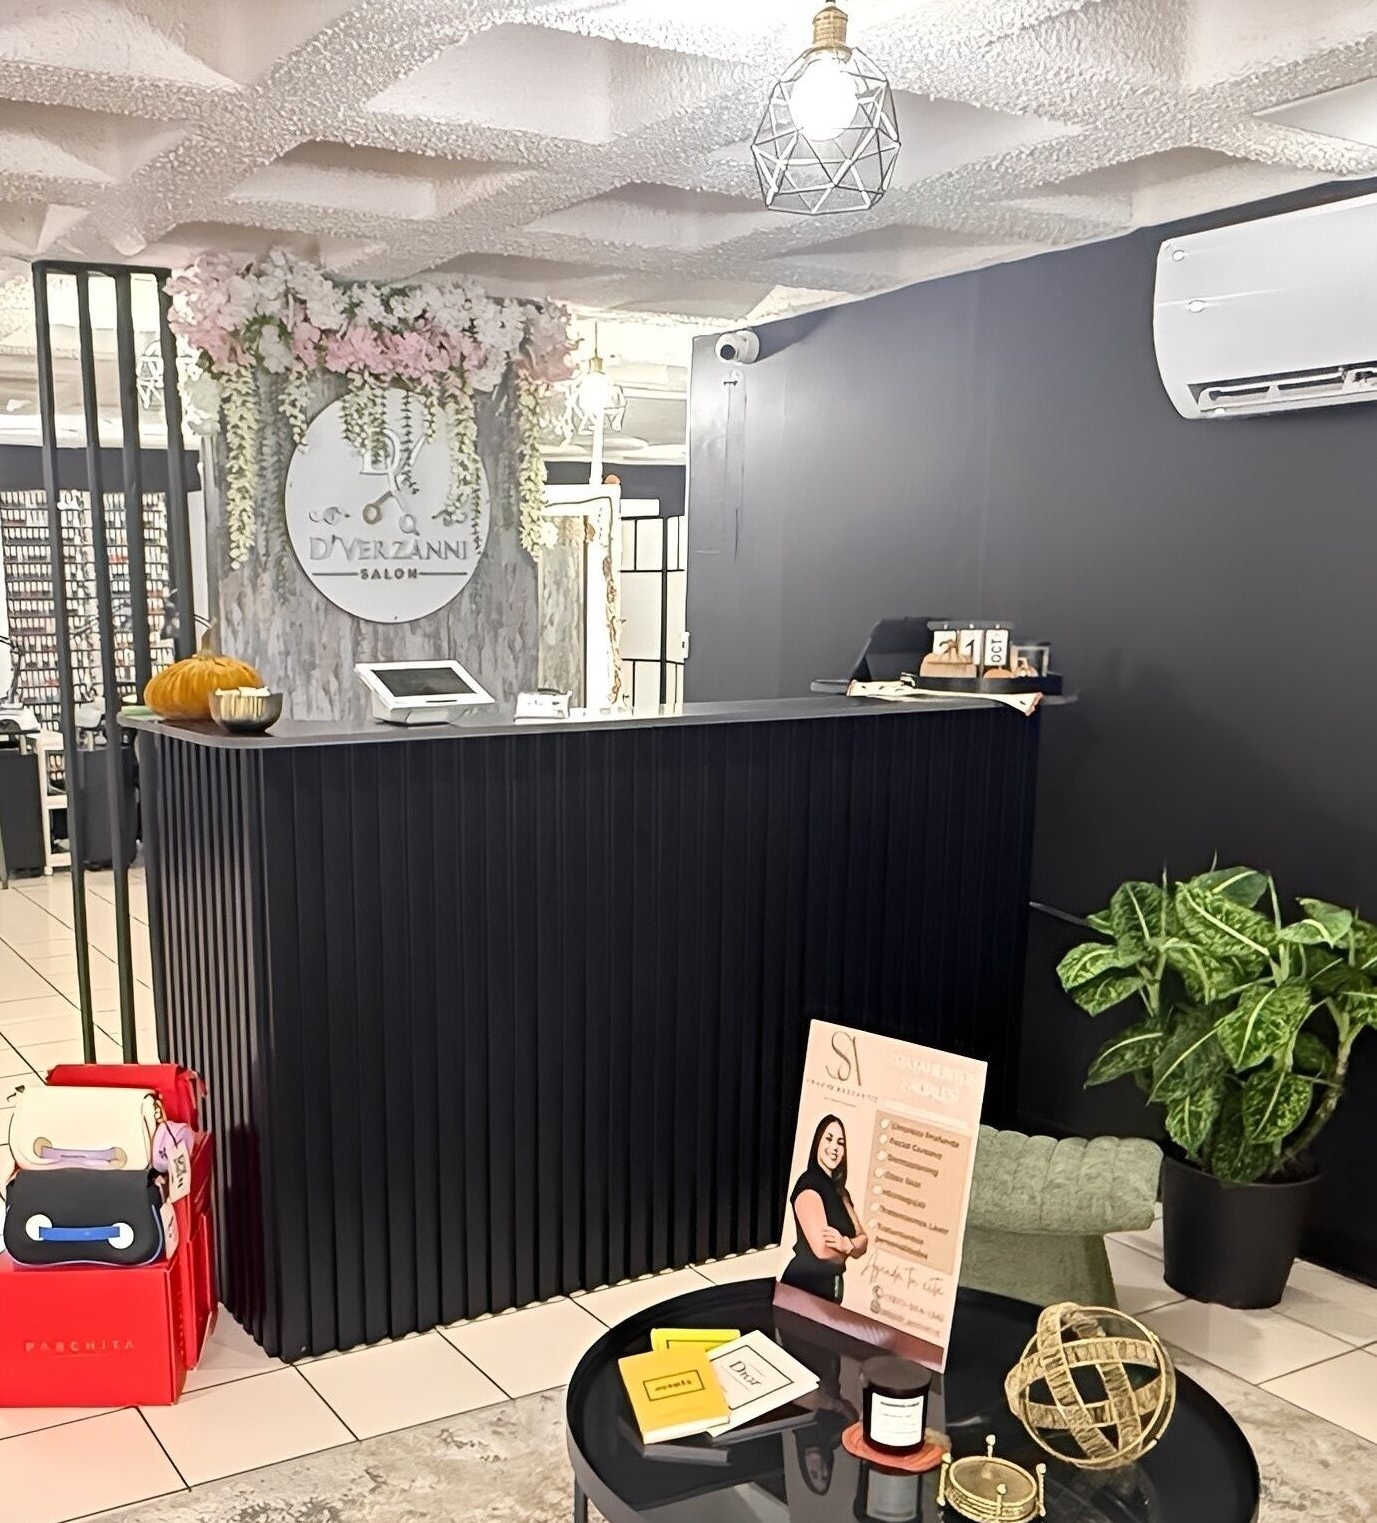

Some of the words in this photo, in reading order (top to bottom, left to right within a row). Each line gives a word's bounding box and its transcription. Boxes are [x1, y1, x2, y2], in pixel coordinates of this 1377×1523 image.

[360, 568, 418, 580] SALON
[990, 638, 1003, 663] OCT
[728, 1360, 762, 1387] Dior
